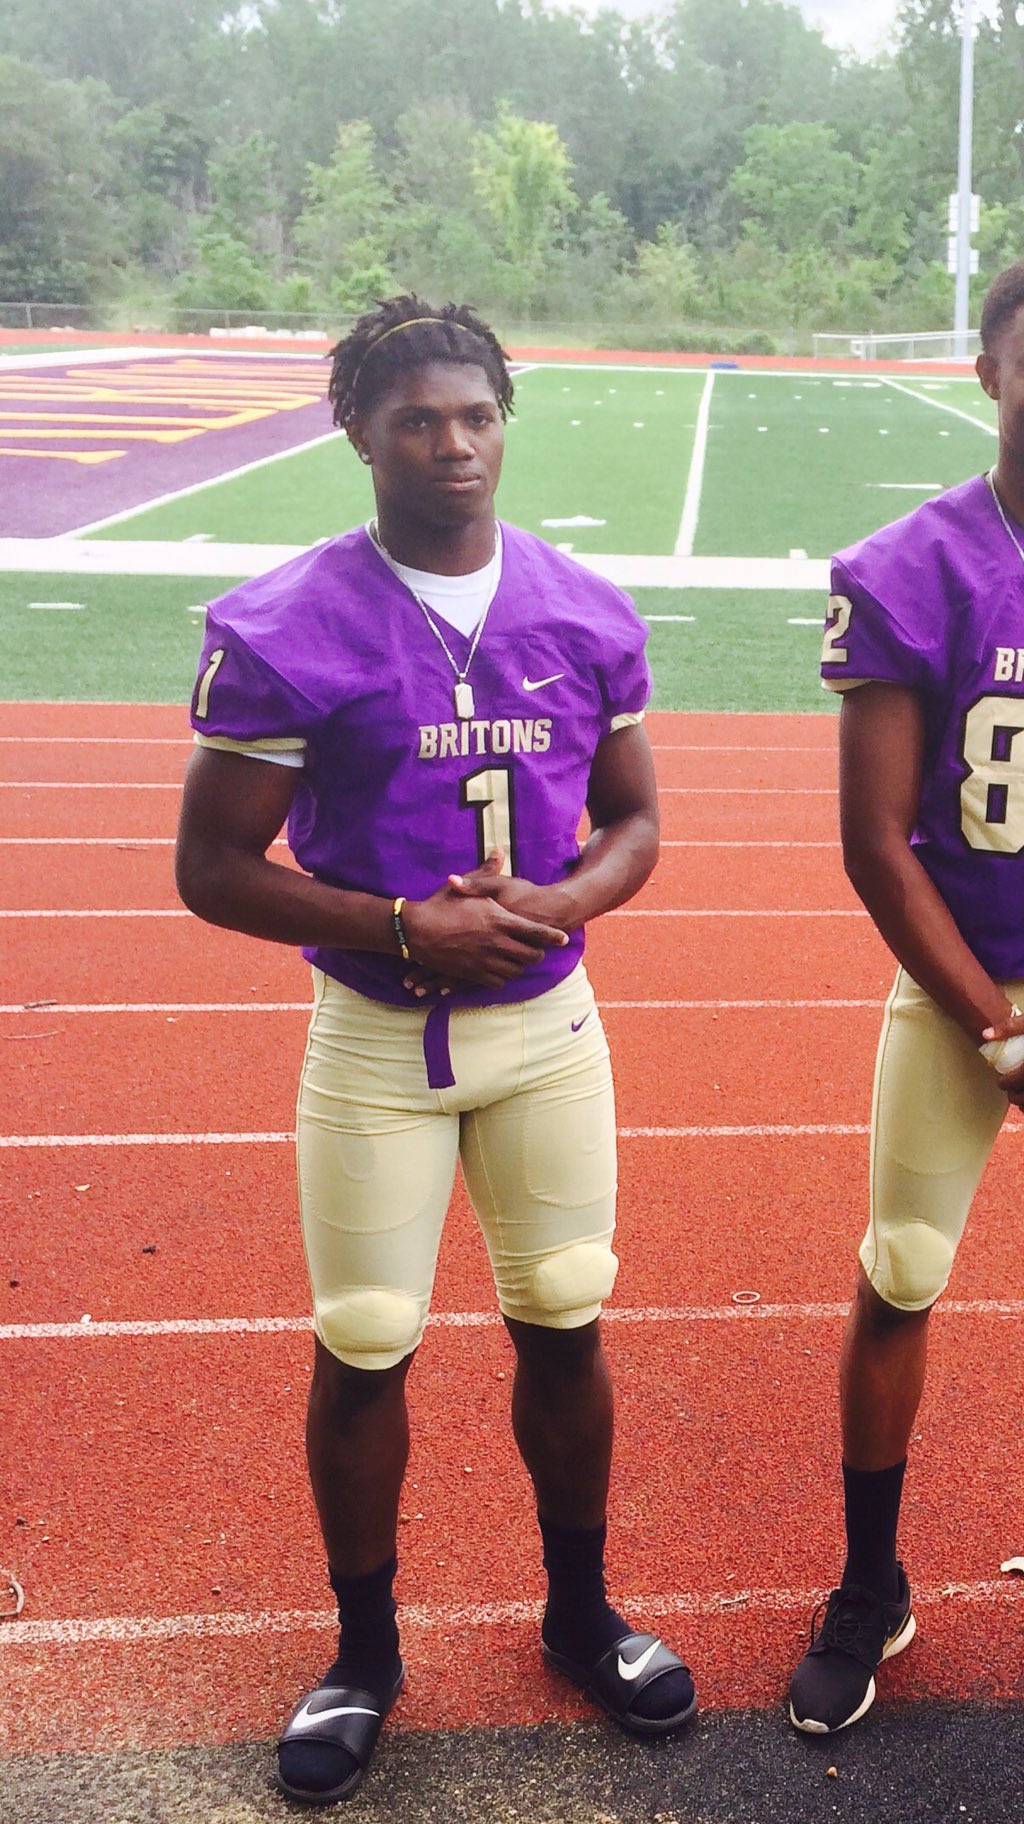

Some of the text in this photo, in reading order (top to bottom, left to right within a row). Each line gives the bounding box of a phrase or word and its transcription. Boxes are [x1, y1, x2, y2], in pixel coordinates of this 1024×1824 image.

[821, 593, 853, 664] 2
[192, 648, 226, 720] 1
[417, 718, 552, 759] BRITONS
[460, 764, 519, 877] 1
